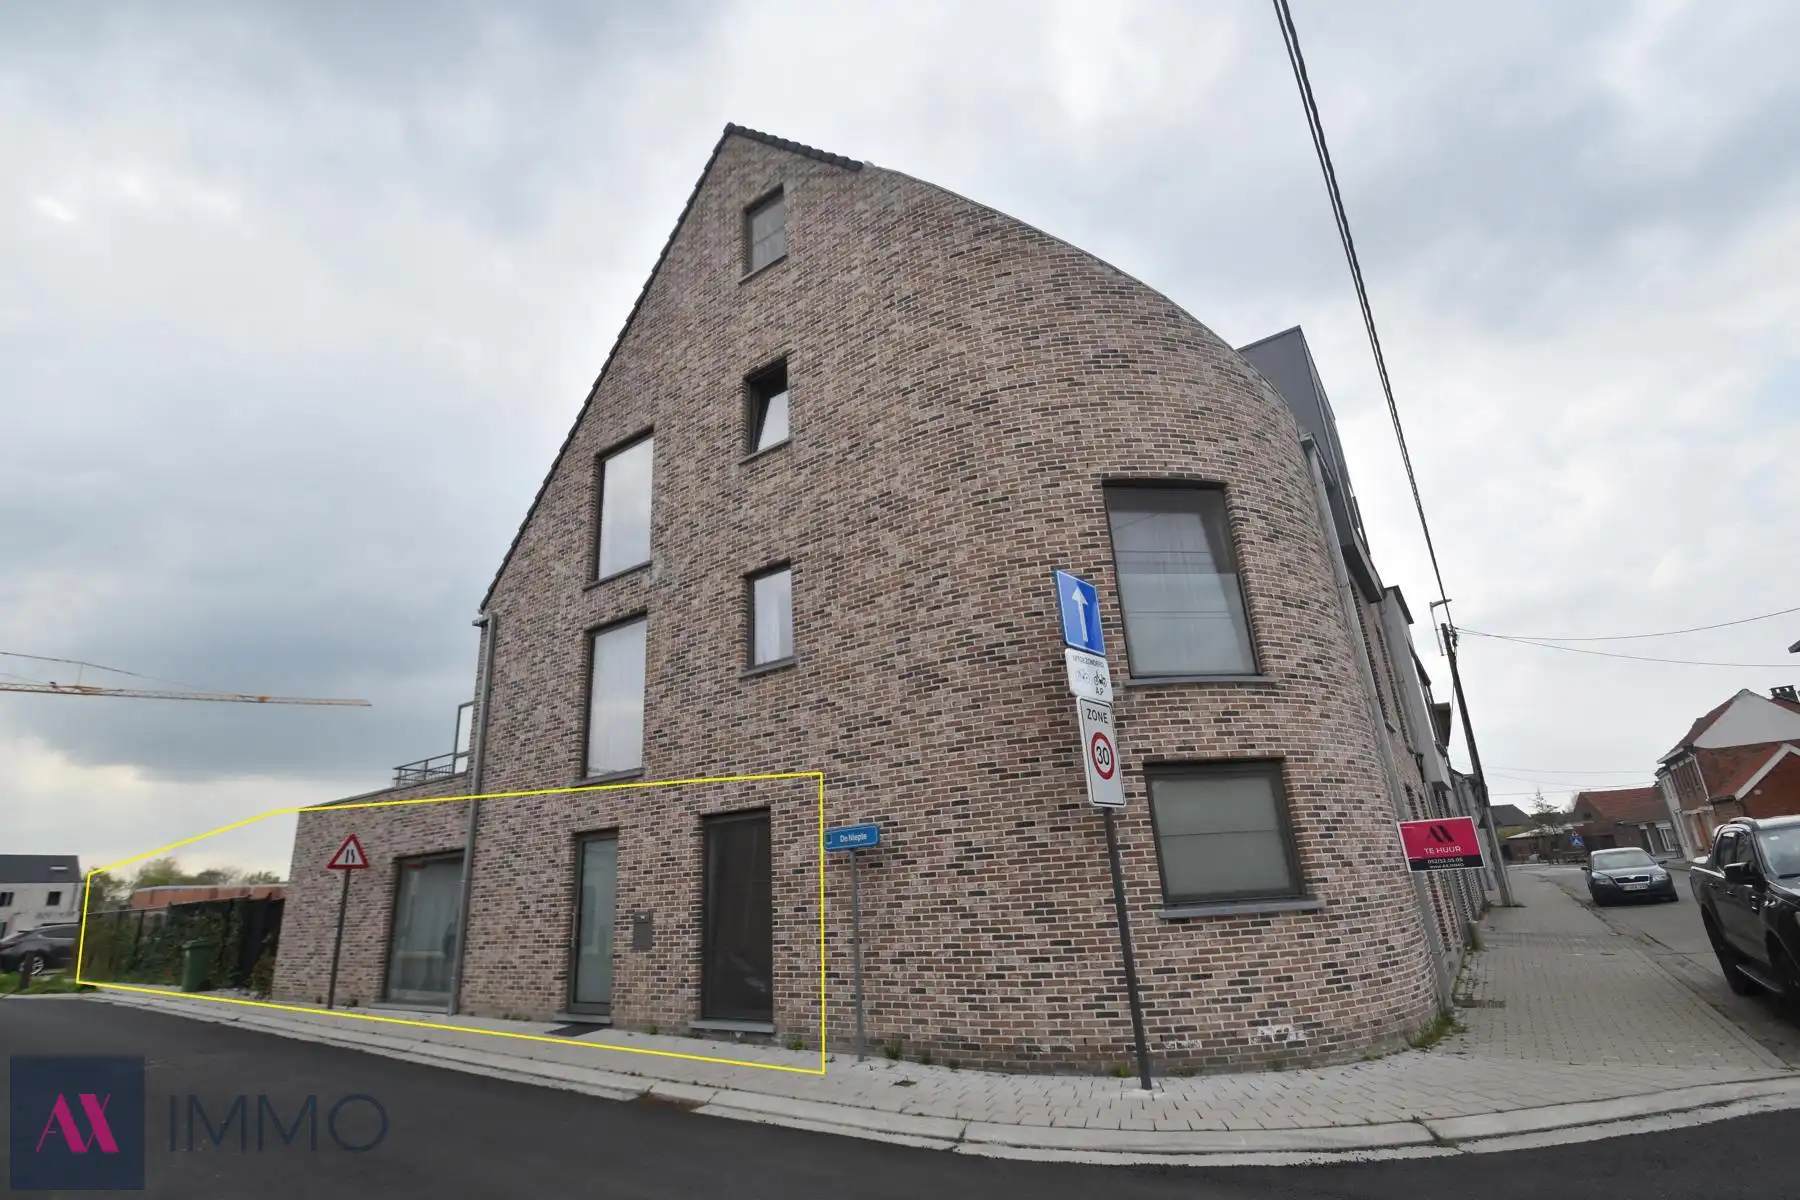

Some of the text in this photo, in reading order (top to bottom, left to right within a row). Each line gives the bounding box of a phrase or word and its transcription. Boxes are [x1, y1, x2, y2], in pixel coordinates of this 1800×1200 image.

[1086, 708, 1109, 724] ZONE
[1096, 746, 1110, 766] 30
[1436, 845, 1461, 854] HUUR
